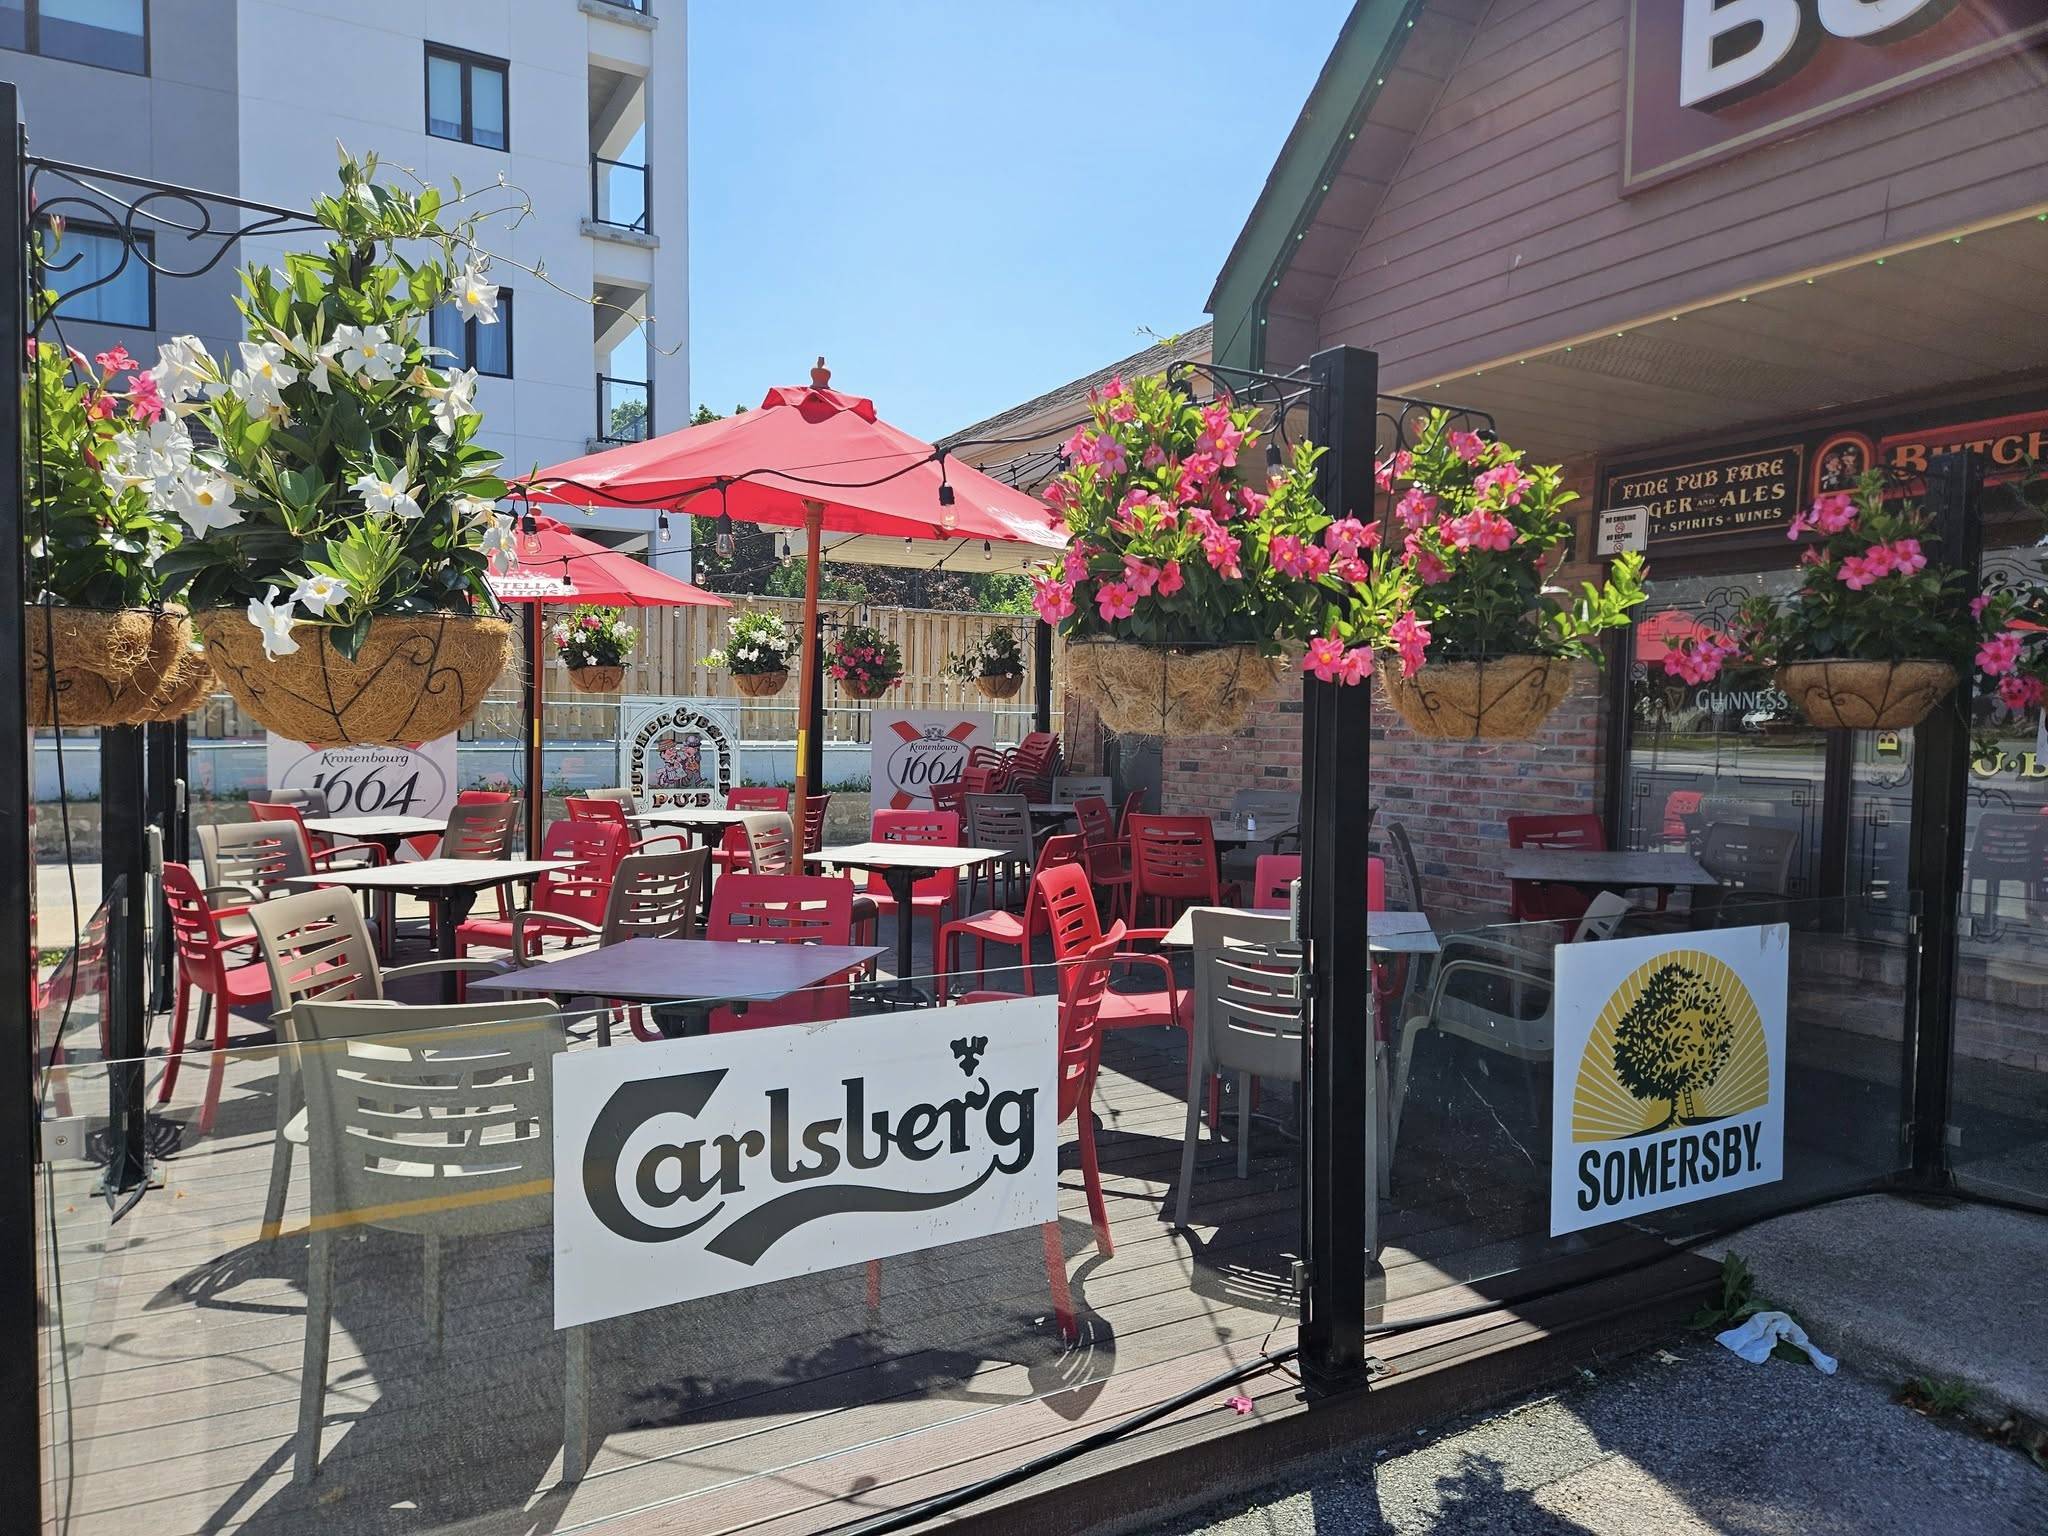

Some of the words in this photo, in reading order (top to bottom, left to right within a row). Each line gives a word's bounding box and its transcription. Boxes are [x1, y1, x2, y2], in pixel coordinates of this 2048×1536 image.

[1622, 478, 1669, 500] FINE
[1676, 469, 1719, 492] PUB
[1725, 458, 1784, 485] FARE
[1697, 498, 1715, 506] AND
[1720, 483, 1786, 507] ALES
[1669, 515, 1724, 532] SPIRITS
[1735, 507, 1783, 523] WINES
[491, 581, 560, 590] STELLA
[1695, 689, 1788, 711] GUINNESS
[630, 712, 672, 799] BUTCHER
[673, 706, 699, 728] &
[694, 715, 731, 798] BANKER
[909, 742, 959, 753] Kronenbourg
[320, 752, 409, 768] Kronenbourg
[900, 752, 963, 785] 1664
[582, 1067, 1039, 1244] Carlsberg
